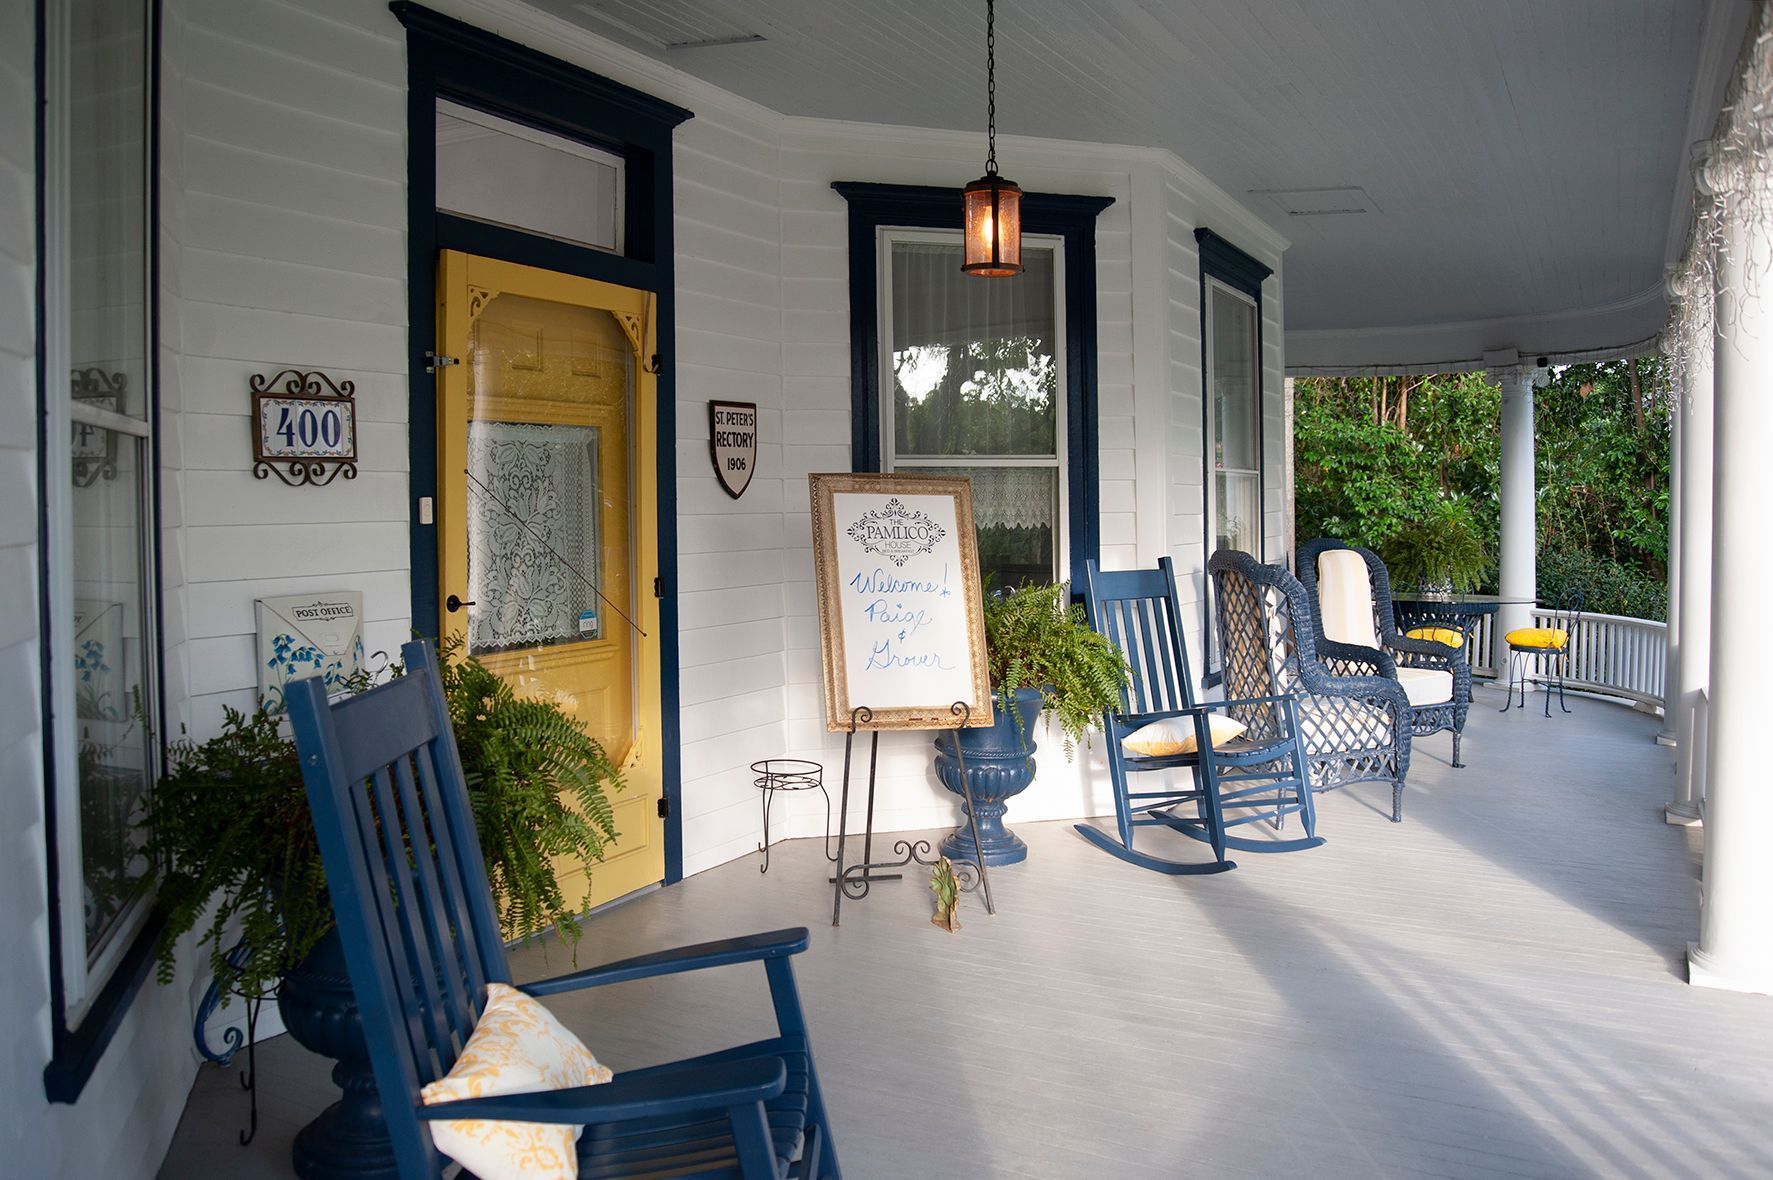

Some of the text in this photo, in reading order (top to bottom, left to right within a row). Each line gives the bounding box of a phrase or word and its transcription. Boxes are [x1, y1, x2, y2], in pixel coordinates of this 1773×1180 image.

[715, 411, 754, 427] ST. PETER'S
[276, 408, 341, 447] 400
[716, 431, 754, 448] RECTORY
[727, 458, 746, 470] 1906
[866, 525, 929, 541] PAMLICO
[884, 540, 912, 549] HOUSE
[296, 606, 352, 617] POST OFFICE
[864, 599, 933, 636] Paige
[865, 639, 956, 671] Grover
